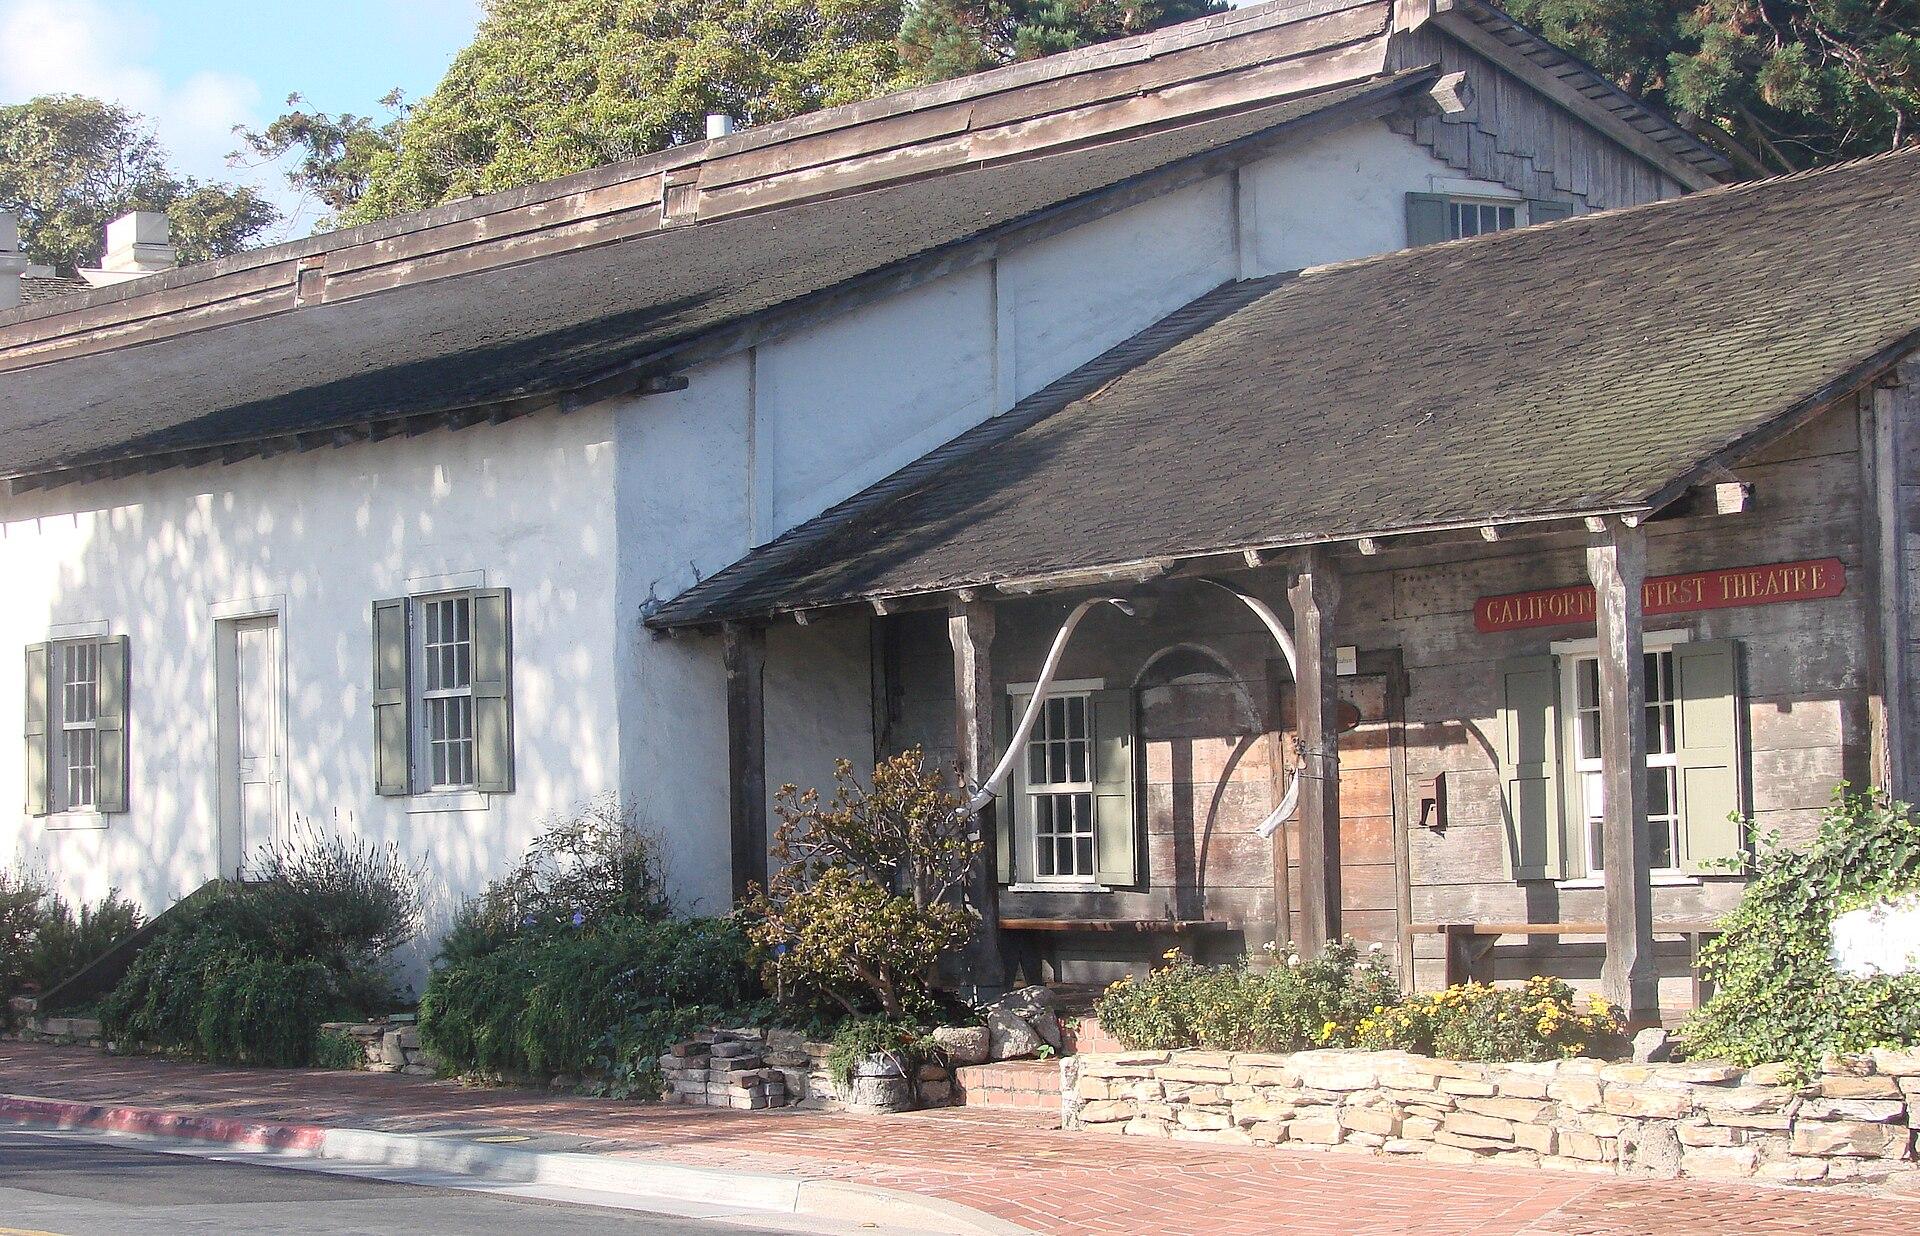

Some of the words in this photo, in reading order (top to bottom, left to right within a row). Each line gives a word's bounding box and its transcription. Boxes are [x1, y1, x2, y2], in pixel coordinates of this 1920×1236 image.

[1487, 591, 1597, 624] CALIFORN
[1644, 577, 1705, 608] FIRST
[1720, 565, 1825, 600] THEATRE
